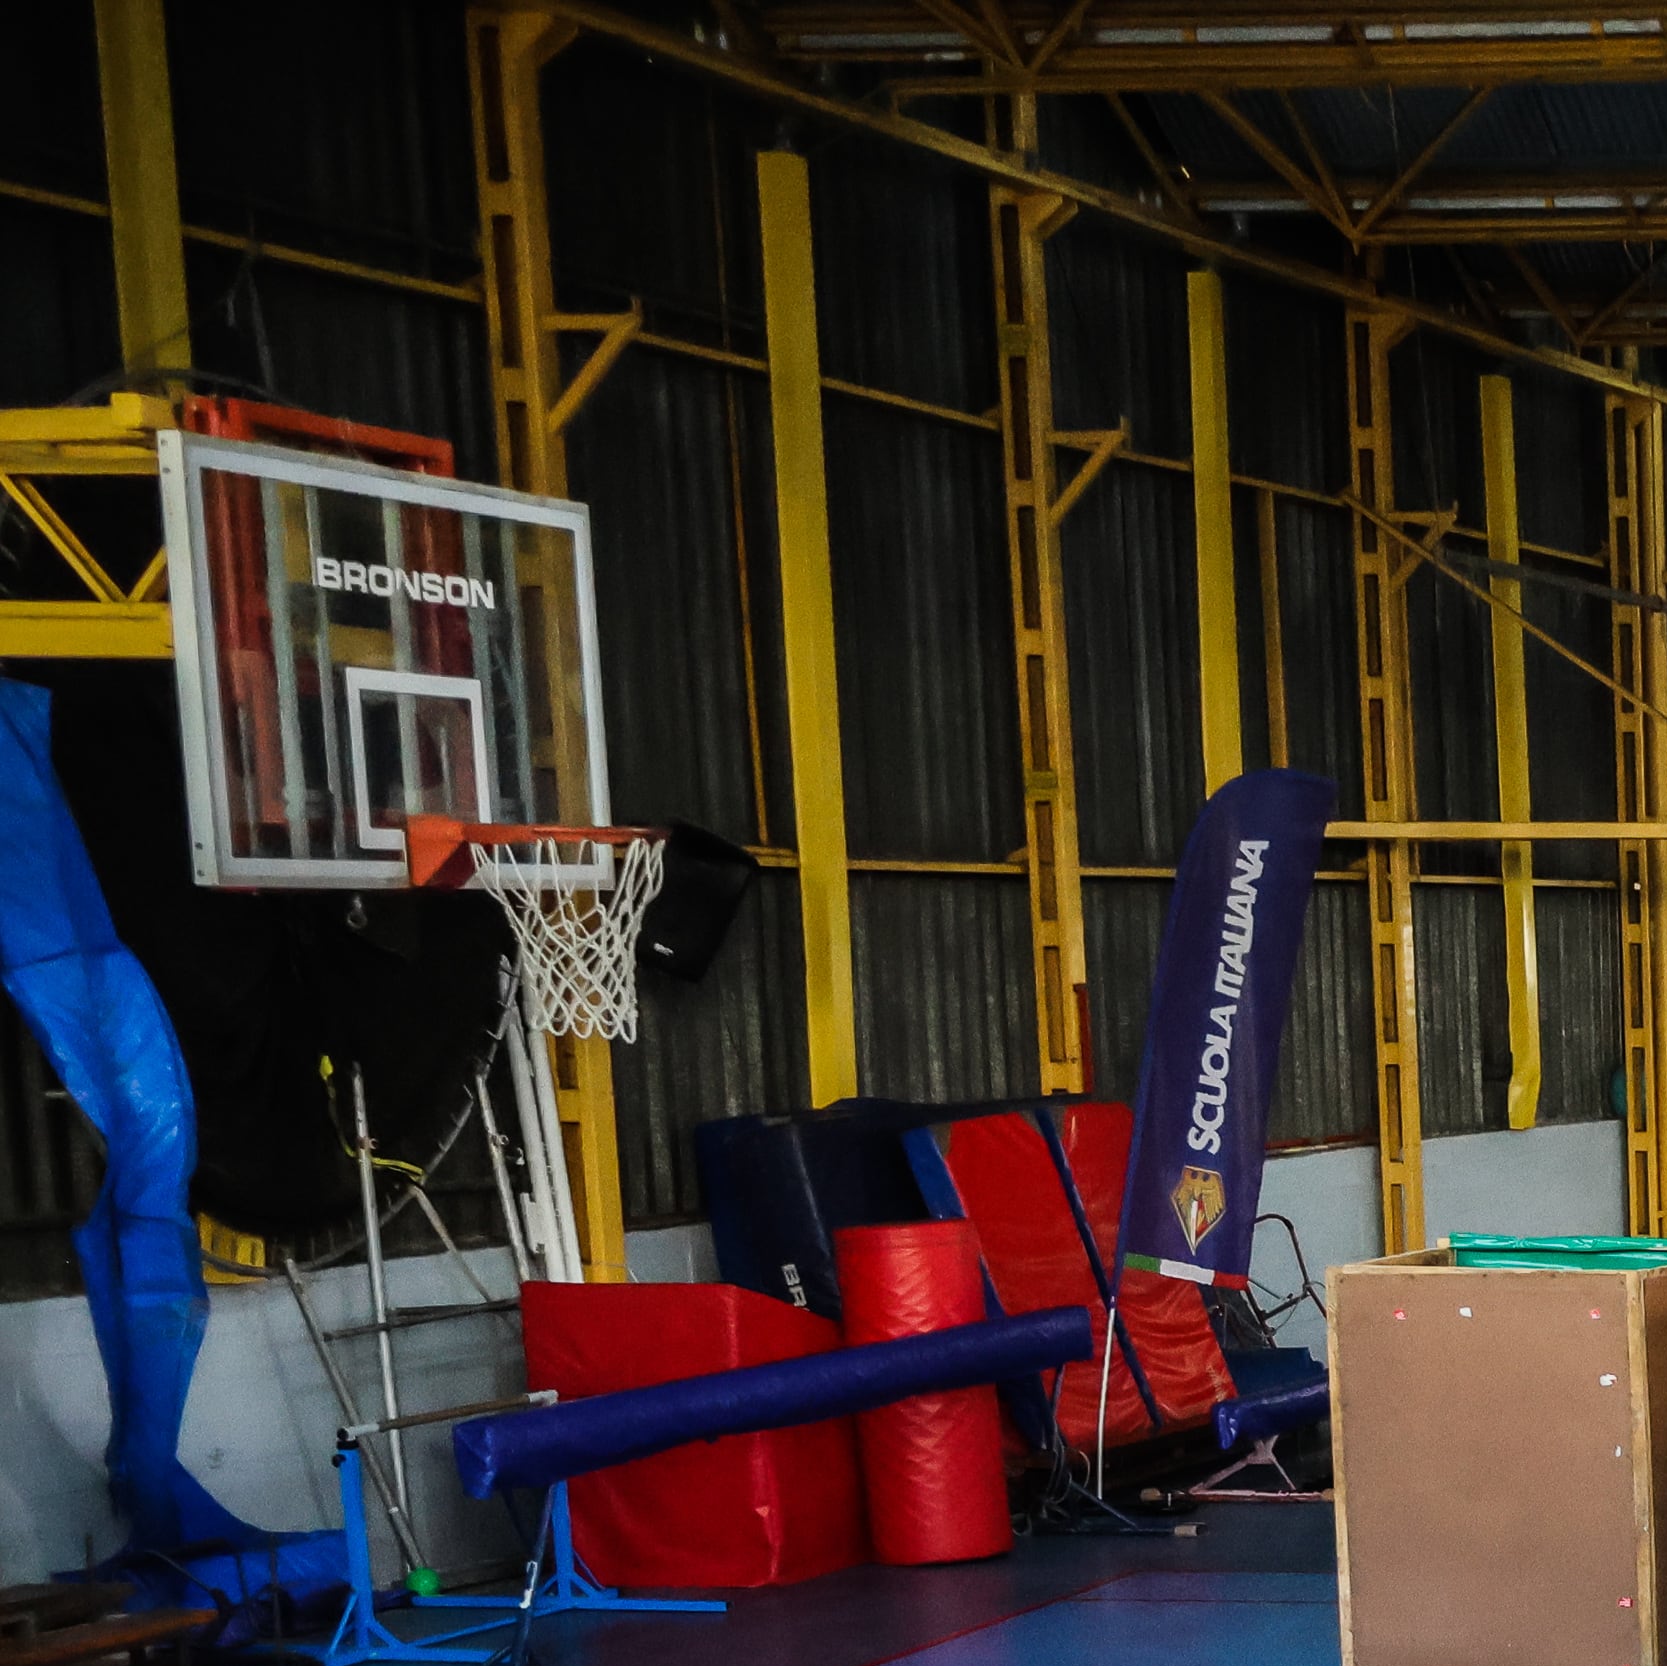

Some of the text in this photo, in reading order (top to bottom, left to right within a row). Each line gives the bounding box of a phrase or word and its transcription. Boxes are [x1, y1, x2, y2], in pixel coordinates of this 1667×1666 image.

[316, 557, 496, 610] BRONSON
[1187, 840, 1270, 1155] SCUOLA ITALIANA
[782, 1264, 810, 1311] BR
